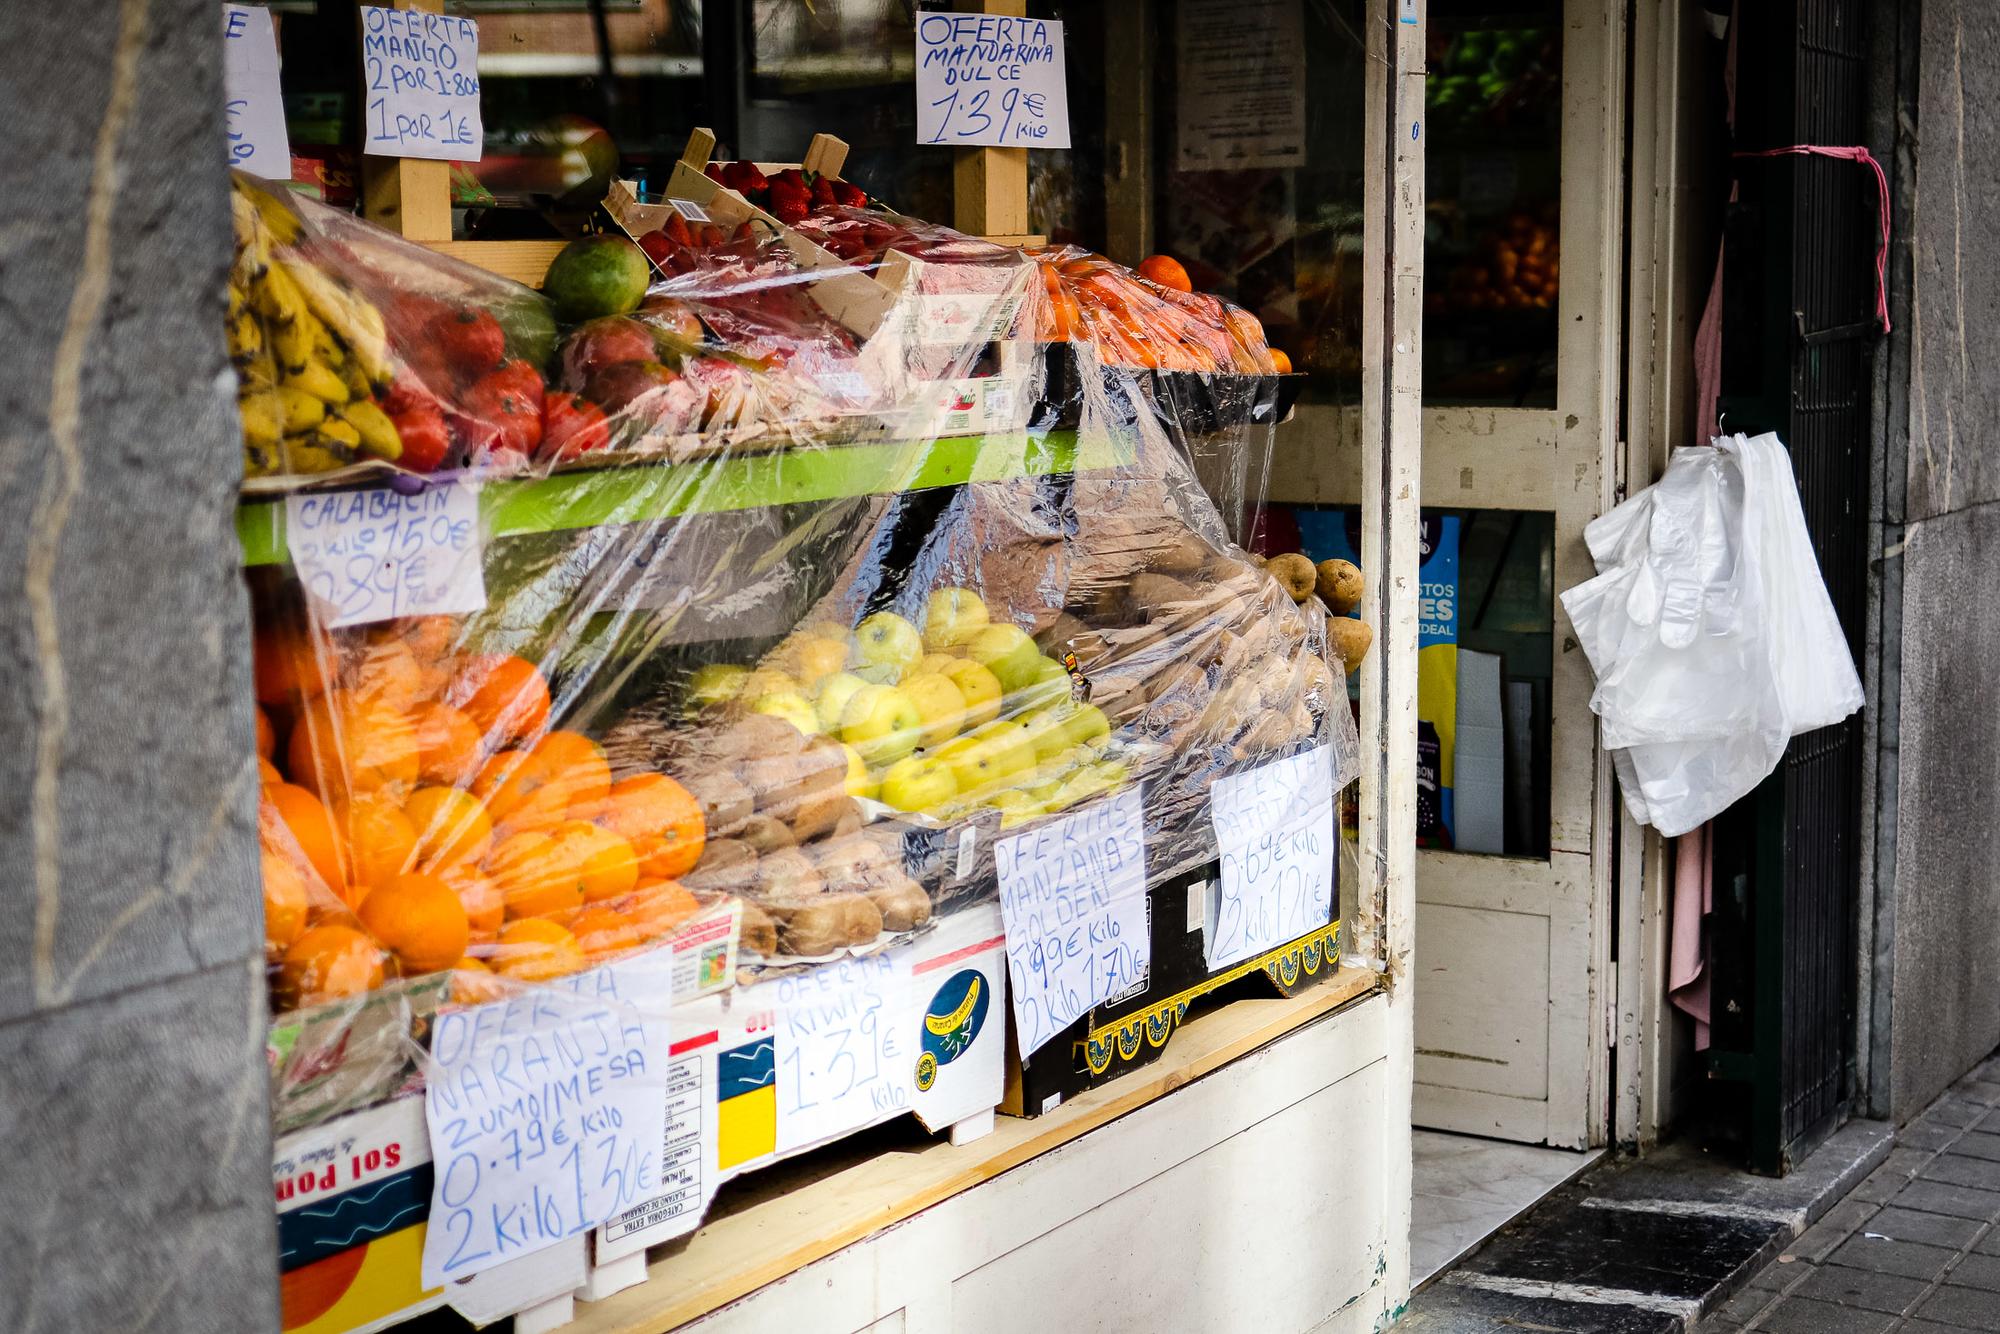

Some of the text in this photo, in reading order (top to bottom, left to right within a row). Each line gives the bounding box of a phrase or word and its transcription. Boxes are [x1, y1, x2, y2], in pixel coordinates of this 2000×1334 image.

[367, 7, 475, 42] OFERTA
[920, 15, 1047, 45] OFERTA
[365, 34, 457, 69] MANGO
[944, 64, 1021, 86] DULCE
[368, 57, 389, 90] 2
[390, 64, 434, 94] POR
[370, 97, 474, 144] 1 POR 1€
[998, 794, 1128, 881] OFERTAS
[1000, 826, 1141, 923] MANZANAS
[1008, 872, 1112, 956] GOLDEN
[1089, 913, 1120, 948] Kilo
[1217, 897, 1241, 960] 2
[778, 952, 893, 1003] OFERTA
[437, 965, 618, 1067] OFERTA
[1023, 997, 1051, 1051] 2
[431, 1000, 647, 1118] NARANJA
[870, 1082, 906, 1112] Kilo
[581, 1105, 623, 1137] Kilo
[352, 1142, 401, 1181] Sol
[443, 1208, 491, 1273] 2
[493, 1184, 562, 1253] Kilo
